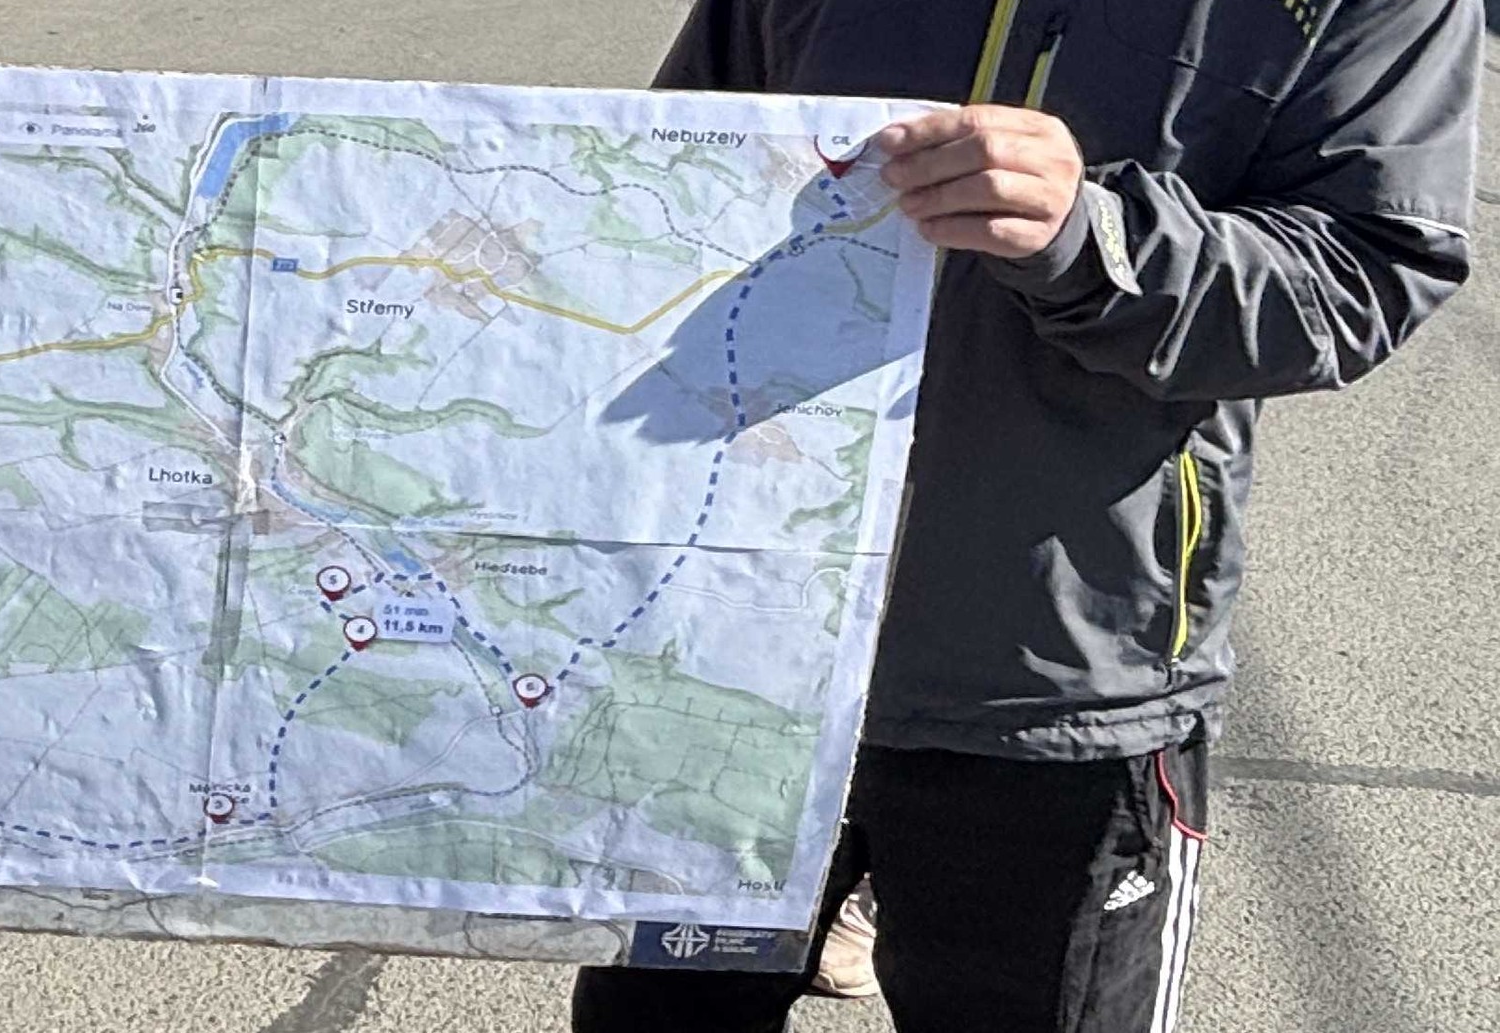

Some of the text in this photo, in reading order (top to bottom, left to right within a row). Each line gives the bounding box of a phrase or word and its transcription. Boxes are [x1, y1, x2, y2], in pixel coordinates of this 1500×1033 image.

[345, 298, 415, 319] Střemy
[148, 466, 213, 485] Lhotka
[417, 621, 444, 634] km
